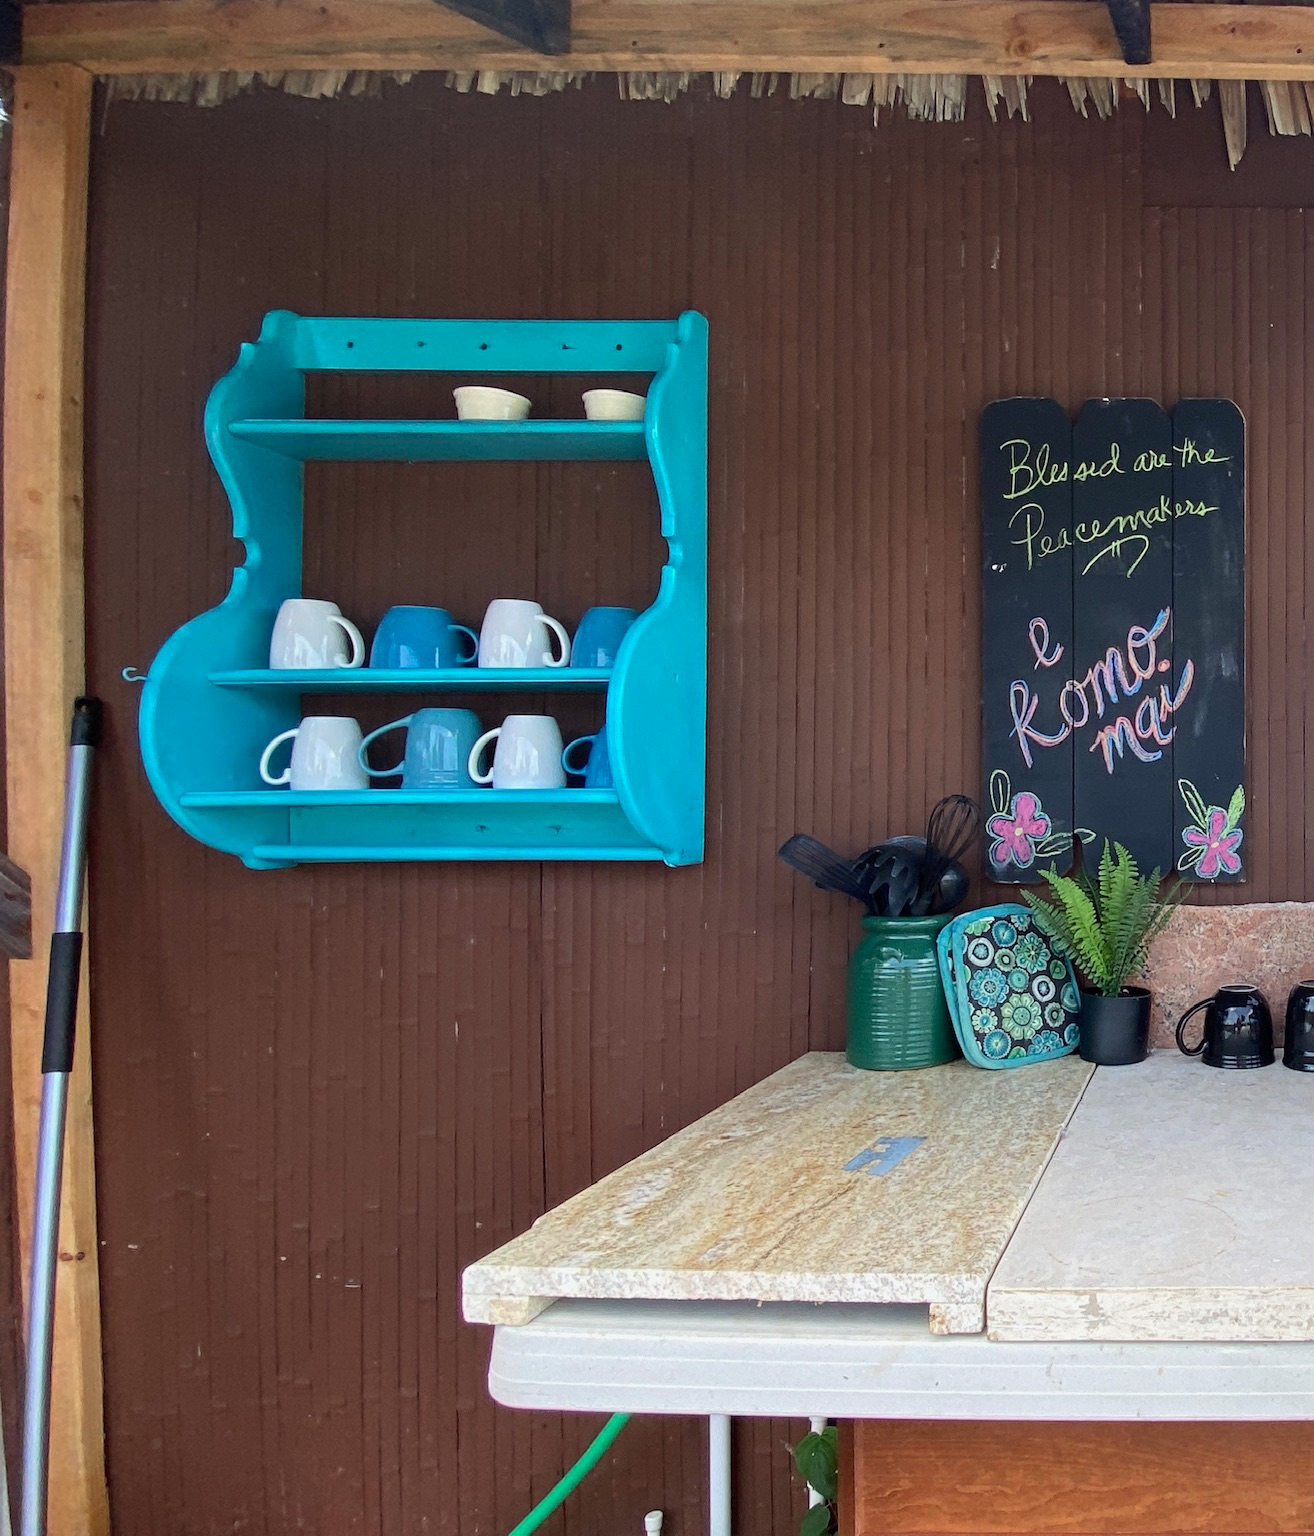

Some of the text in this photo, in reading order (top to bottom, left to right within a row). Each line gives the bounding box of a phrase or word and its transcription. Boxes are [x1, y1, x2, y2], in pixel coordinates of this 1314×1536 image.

[1000, 437, 1231, 499] Blessed are the
[1008, 495, 1220, 571] Peacemakers
